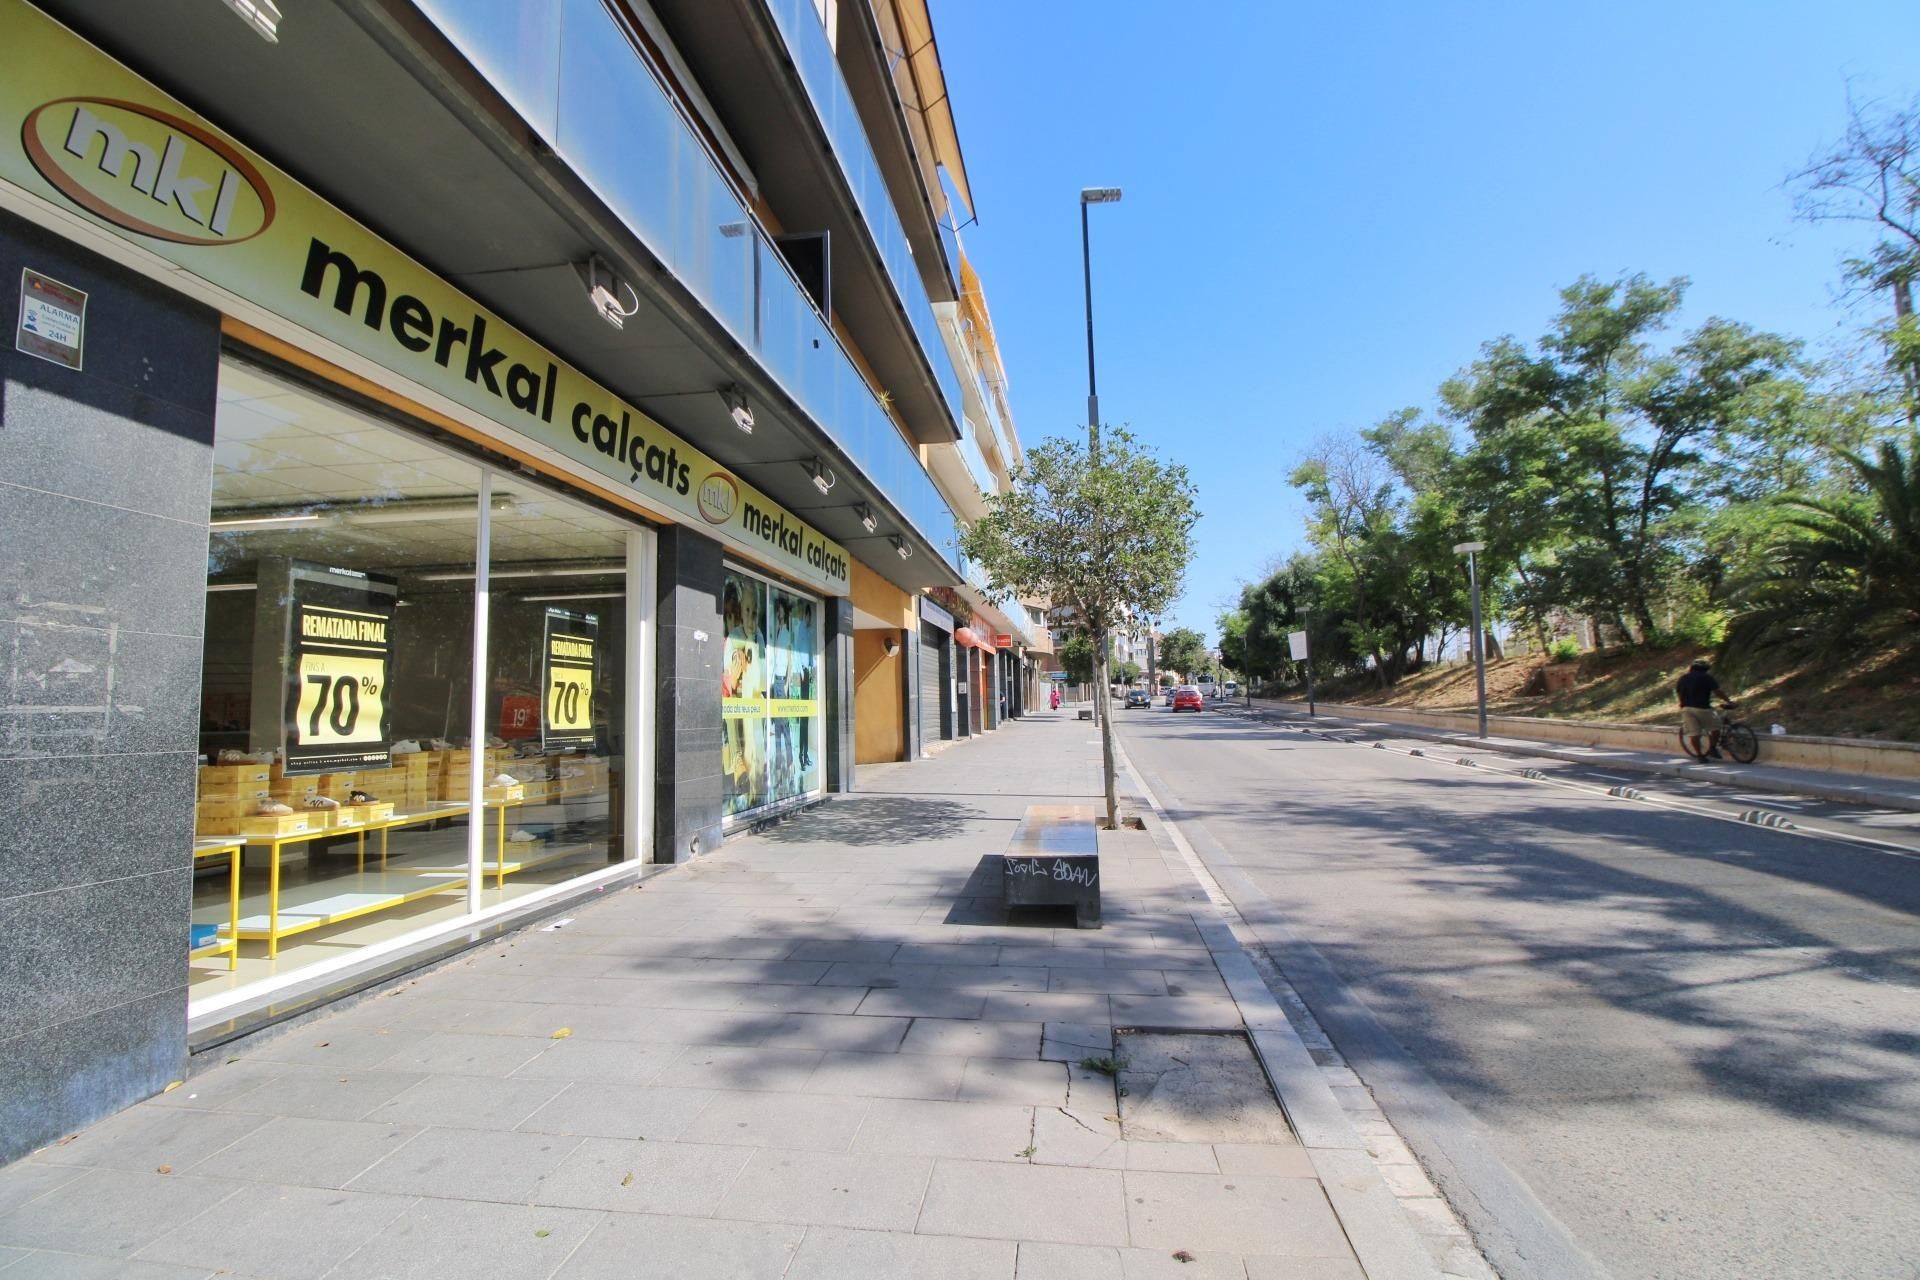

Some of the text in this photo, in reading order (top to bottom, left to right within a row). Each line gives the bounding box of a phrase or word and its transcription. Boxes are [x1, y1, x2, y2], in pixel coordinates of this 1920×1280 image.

[63, 106, 240, 237] mkl
[40, 303, 79, 324] ALARMA
[48, 329, 67, 343] 24H
[301, 236, 691, 496] merkal calçats
[743, 501, 847, 582] merkal calçats
[302, 614, 387, 643] REMATADA FINAL
